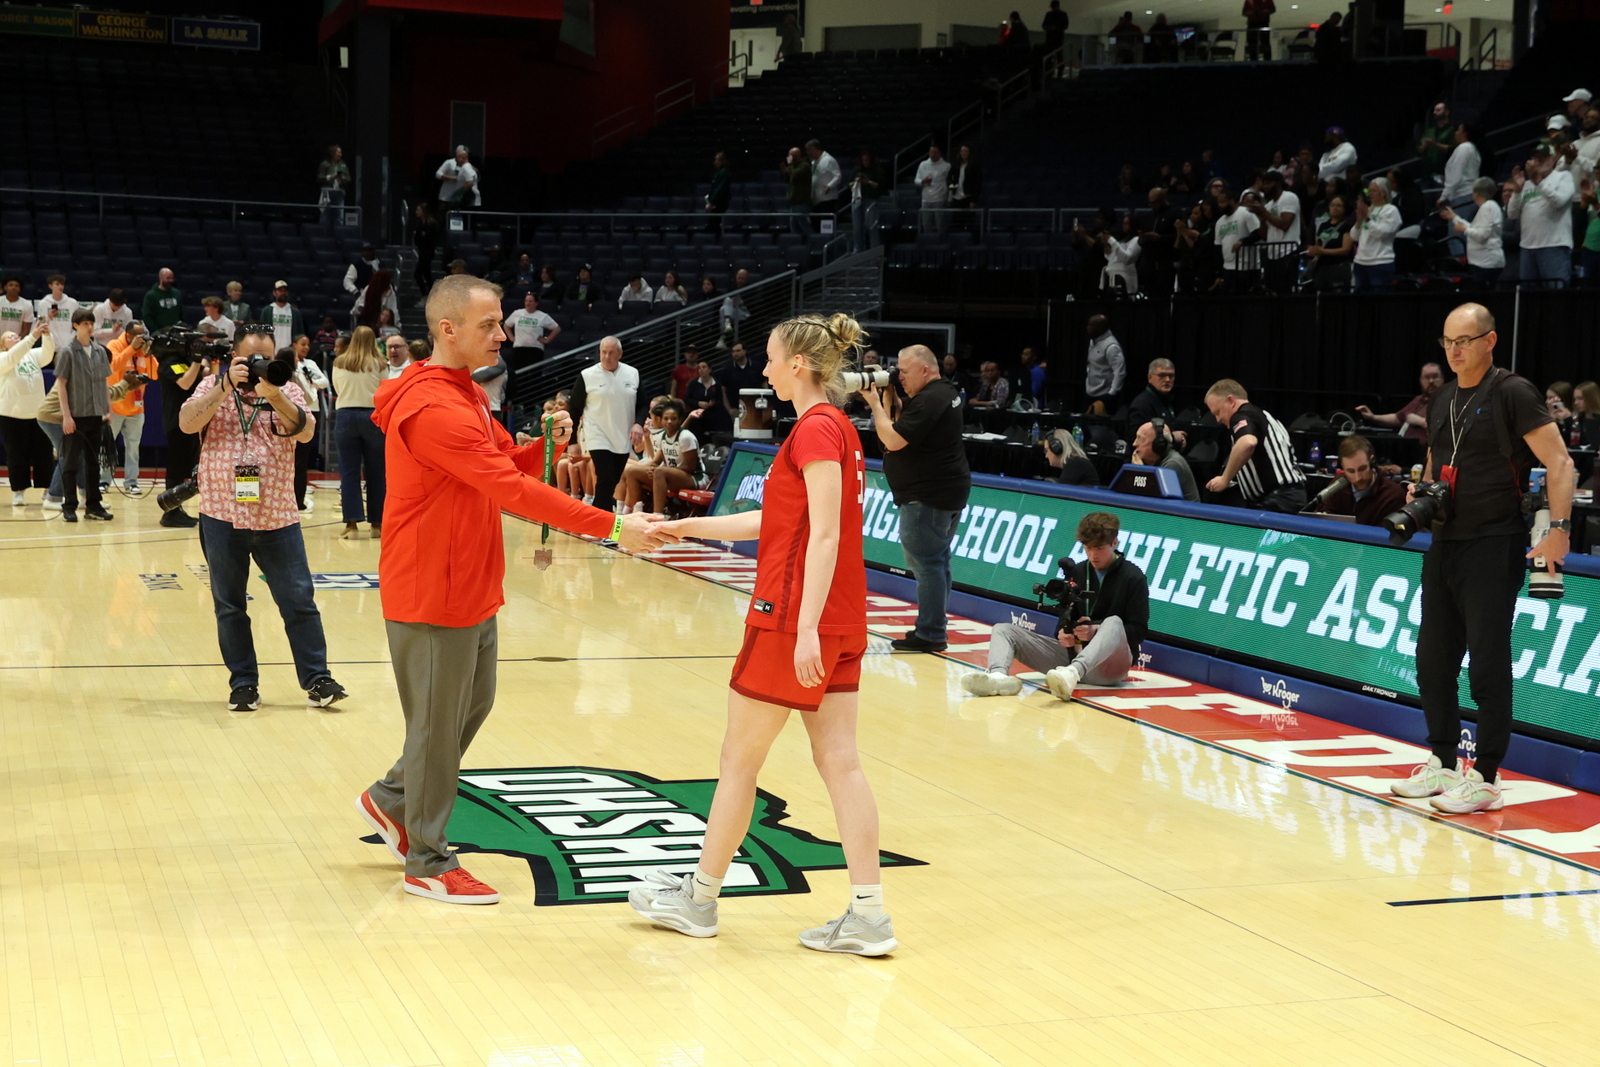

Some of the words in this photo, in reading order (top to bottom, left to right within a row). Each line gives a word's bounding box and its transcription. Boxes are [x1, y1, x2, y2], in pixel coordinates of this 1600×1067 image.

[33, 16, 73, 26] MASON
[97, 15, 148, 28] GEORGE
[81, 25, 164, 40] WASHINGTON
[184, 26, 203, 38] LA
[207, 27, 248, 41] SALLE
[1133, 475, 1147, 488] POSS
[734, 474, 765, 505] OHSA
[949, 503, 1058, 576] CHOOL
[1306, 567, 1600, 698] ASCIA
[1272, 679, 1300, 709] Kroger
[1361, 684, 1398, 699] DAKTRONICS
